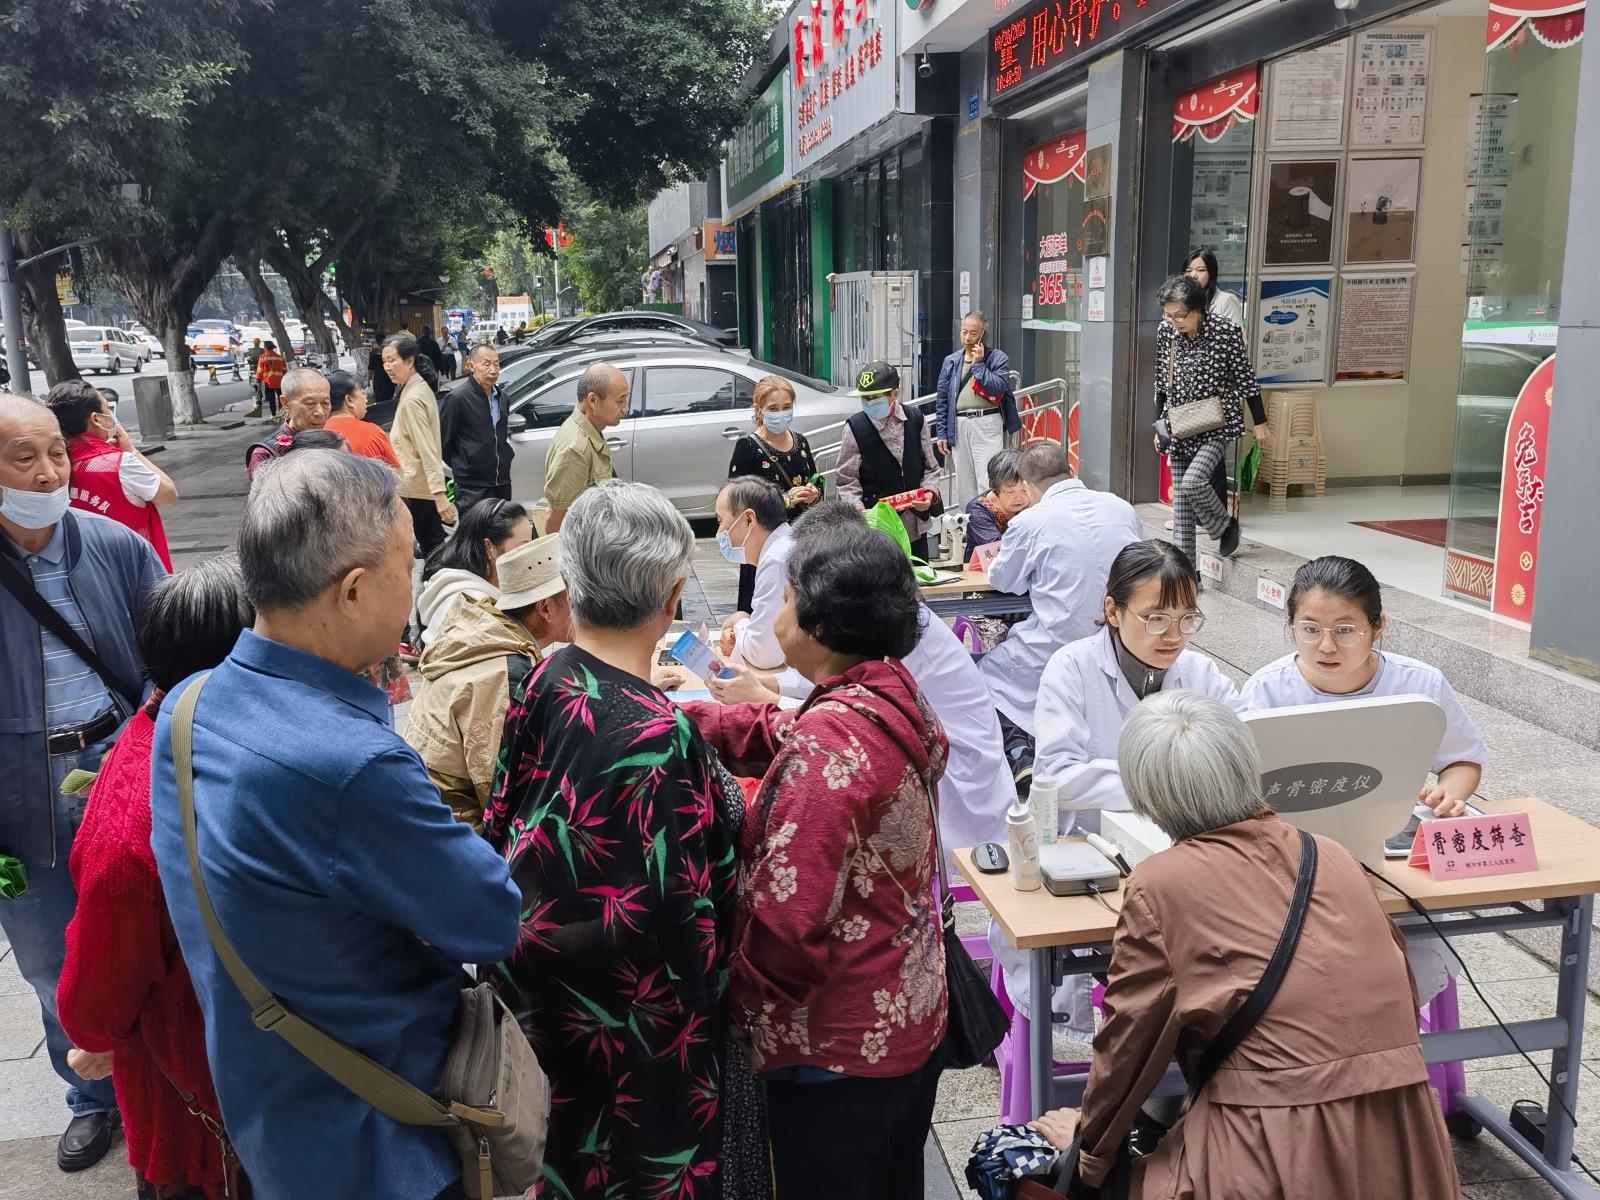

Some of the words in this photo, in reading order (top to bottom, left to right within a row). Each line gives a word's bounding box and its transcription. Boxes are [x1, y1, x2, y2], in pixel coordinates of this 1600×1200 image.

[1262, 774, 1372, 800] 声骨密度仪
[1431, 822, 1527, 856] 骨密度筛查
